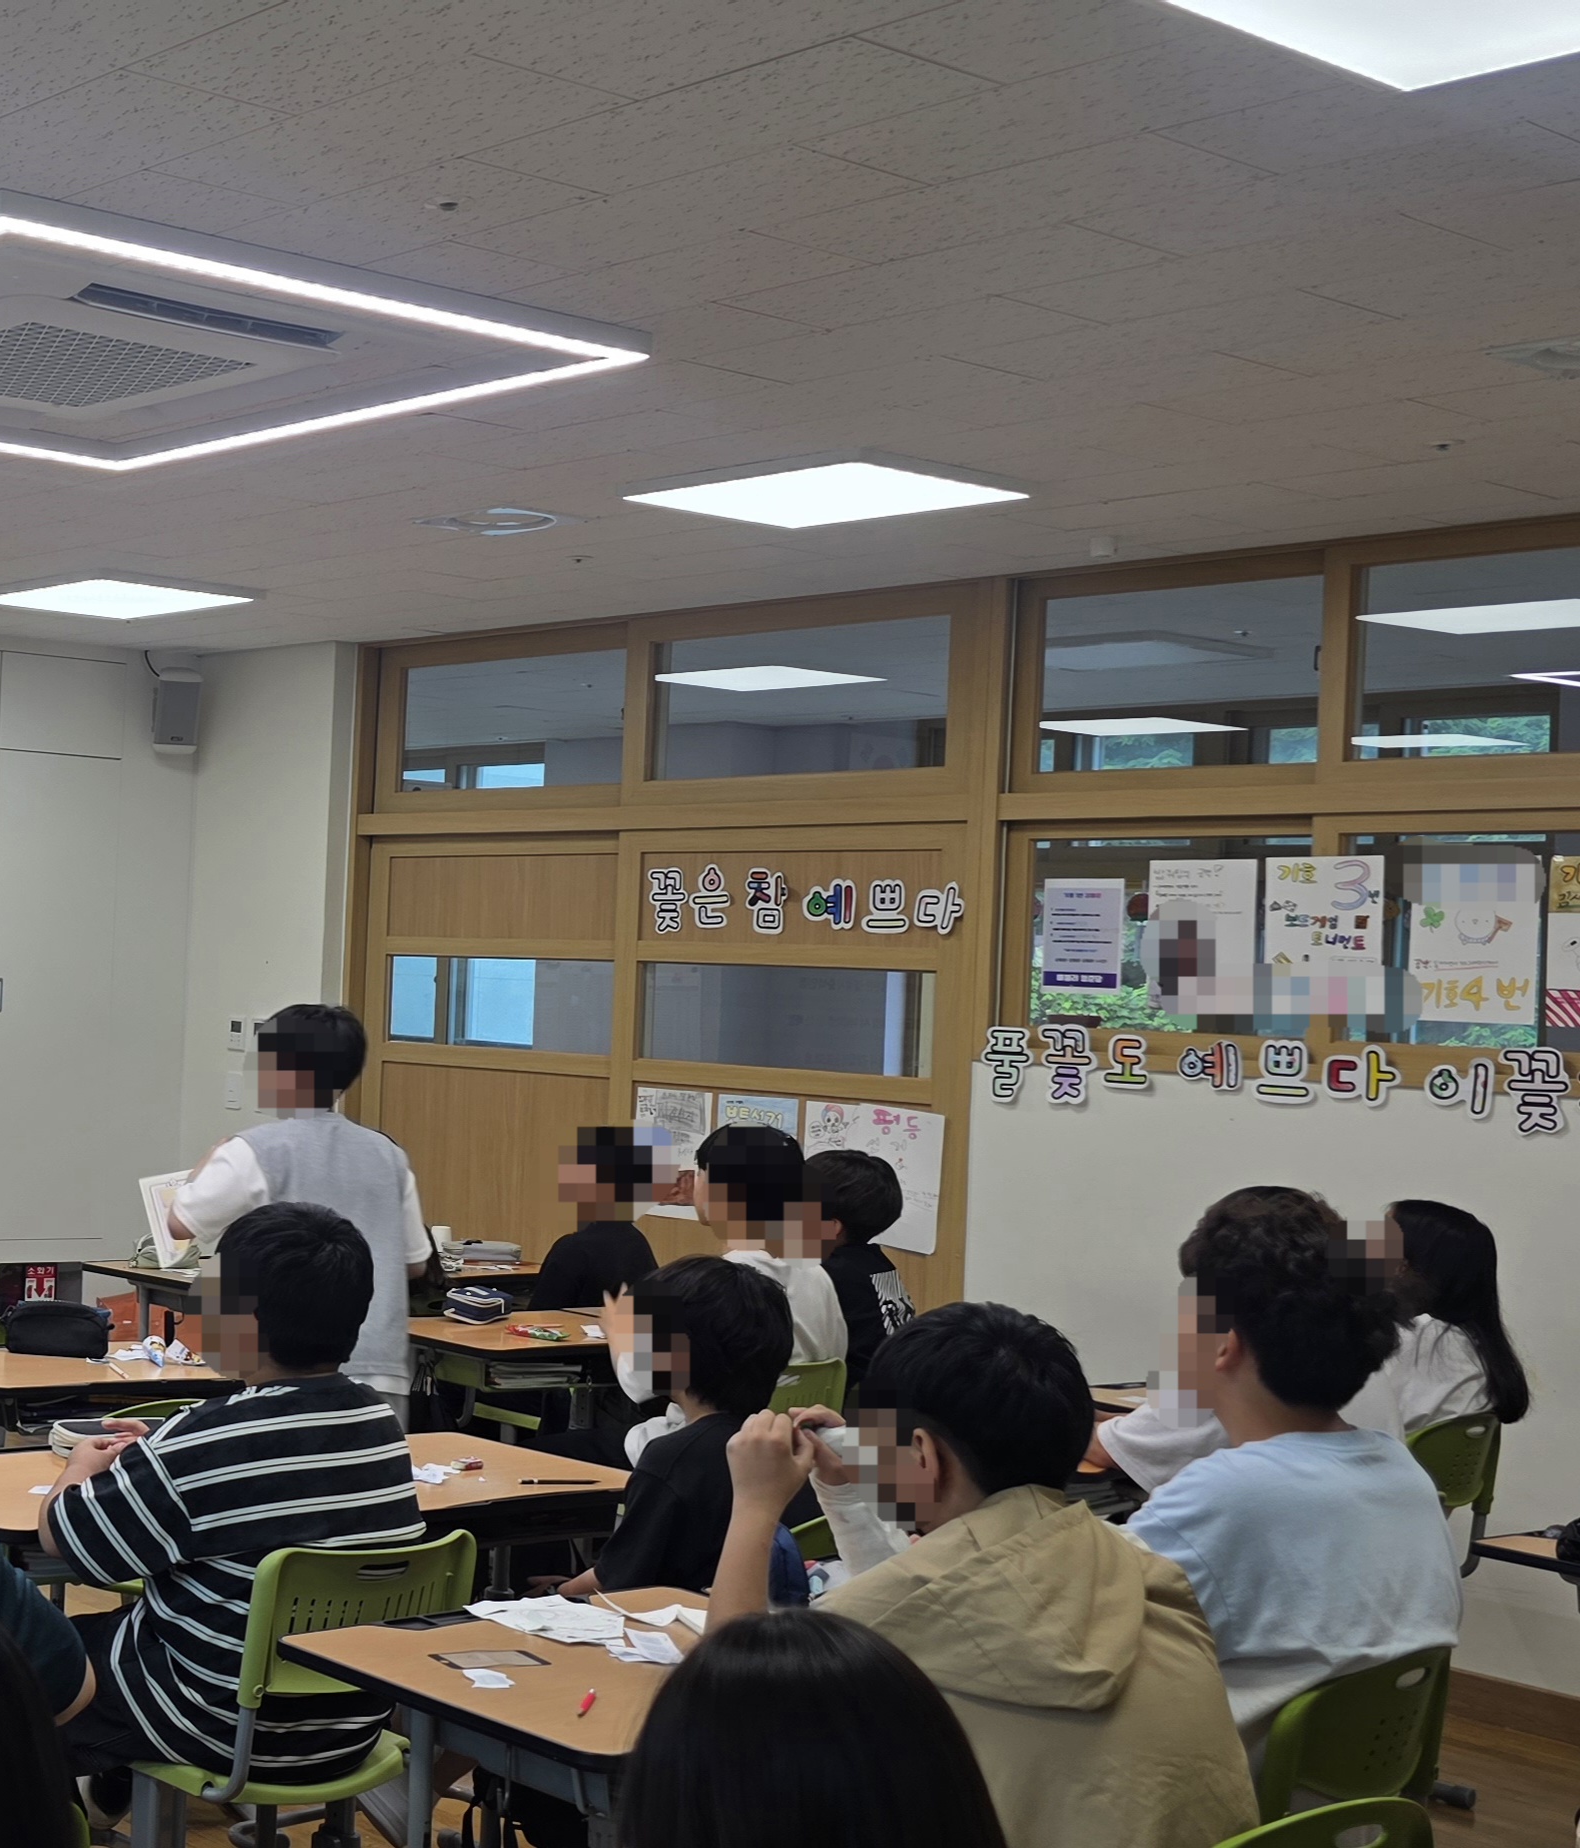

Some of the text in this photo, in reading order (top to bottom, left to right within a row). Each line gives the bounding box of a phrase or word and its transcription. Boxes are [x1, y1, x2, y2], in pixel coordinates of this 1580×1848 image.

[1277, 862, 1318, 884] 기호
[648, 863, 965, 935] 꽃은 참 예쁘다
[1310, 930, 1367, 951] 토너먼트
[982, 1023, 1155, 1105] 풀꽃도
[1177, 1039, 1402, 1107] 예쁘다
[872, 1108, 921, 1139] 평등
[27, 1266, 55, 1275] 소화기
